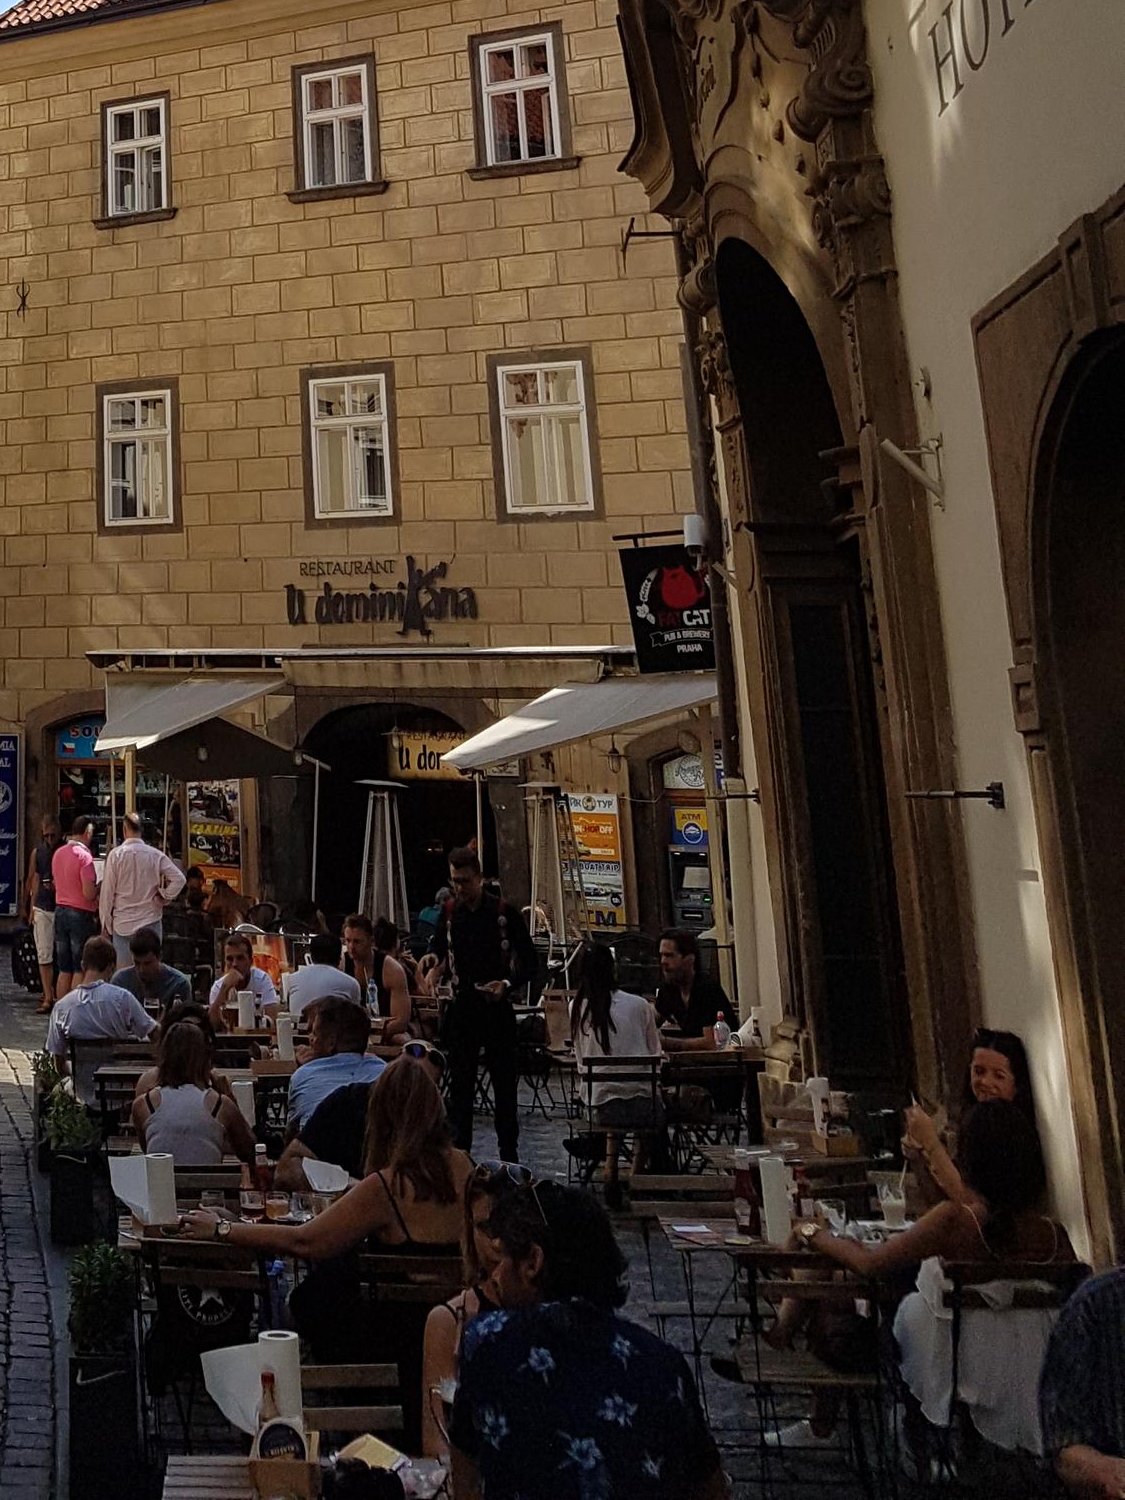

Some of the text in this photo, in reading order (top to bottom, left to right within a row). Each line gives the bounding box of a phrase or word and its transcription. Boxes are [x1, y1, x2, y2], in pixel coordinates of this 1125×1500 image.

[299, 560, 395, 577] RESTAURANT
[658, 609, 711, 627] FAT CAT
[664, 631, 676, 642] PUB
[681, 630, 711, 639] BREWERY
[676, 643, 703, 653] PRAHA
[680, 813, 701, 821] ATM
